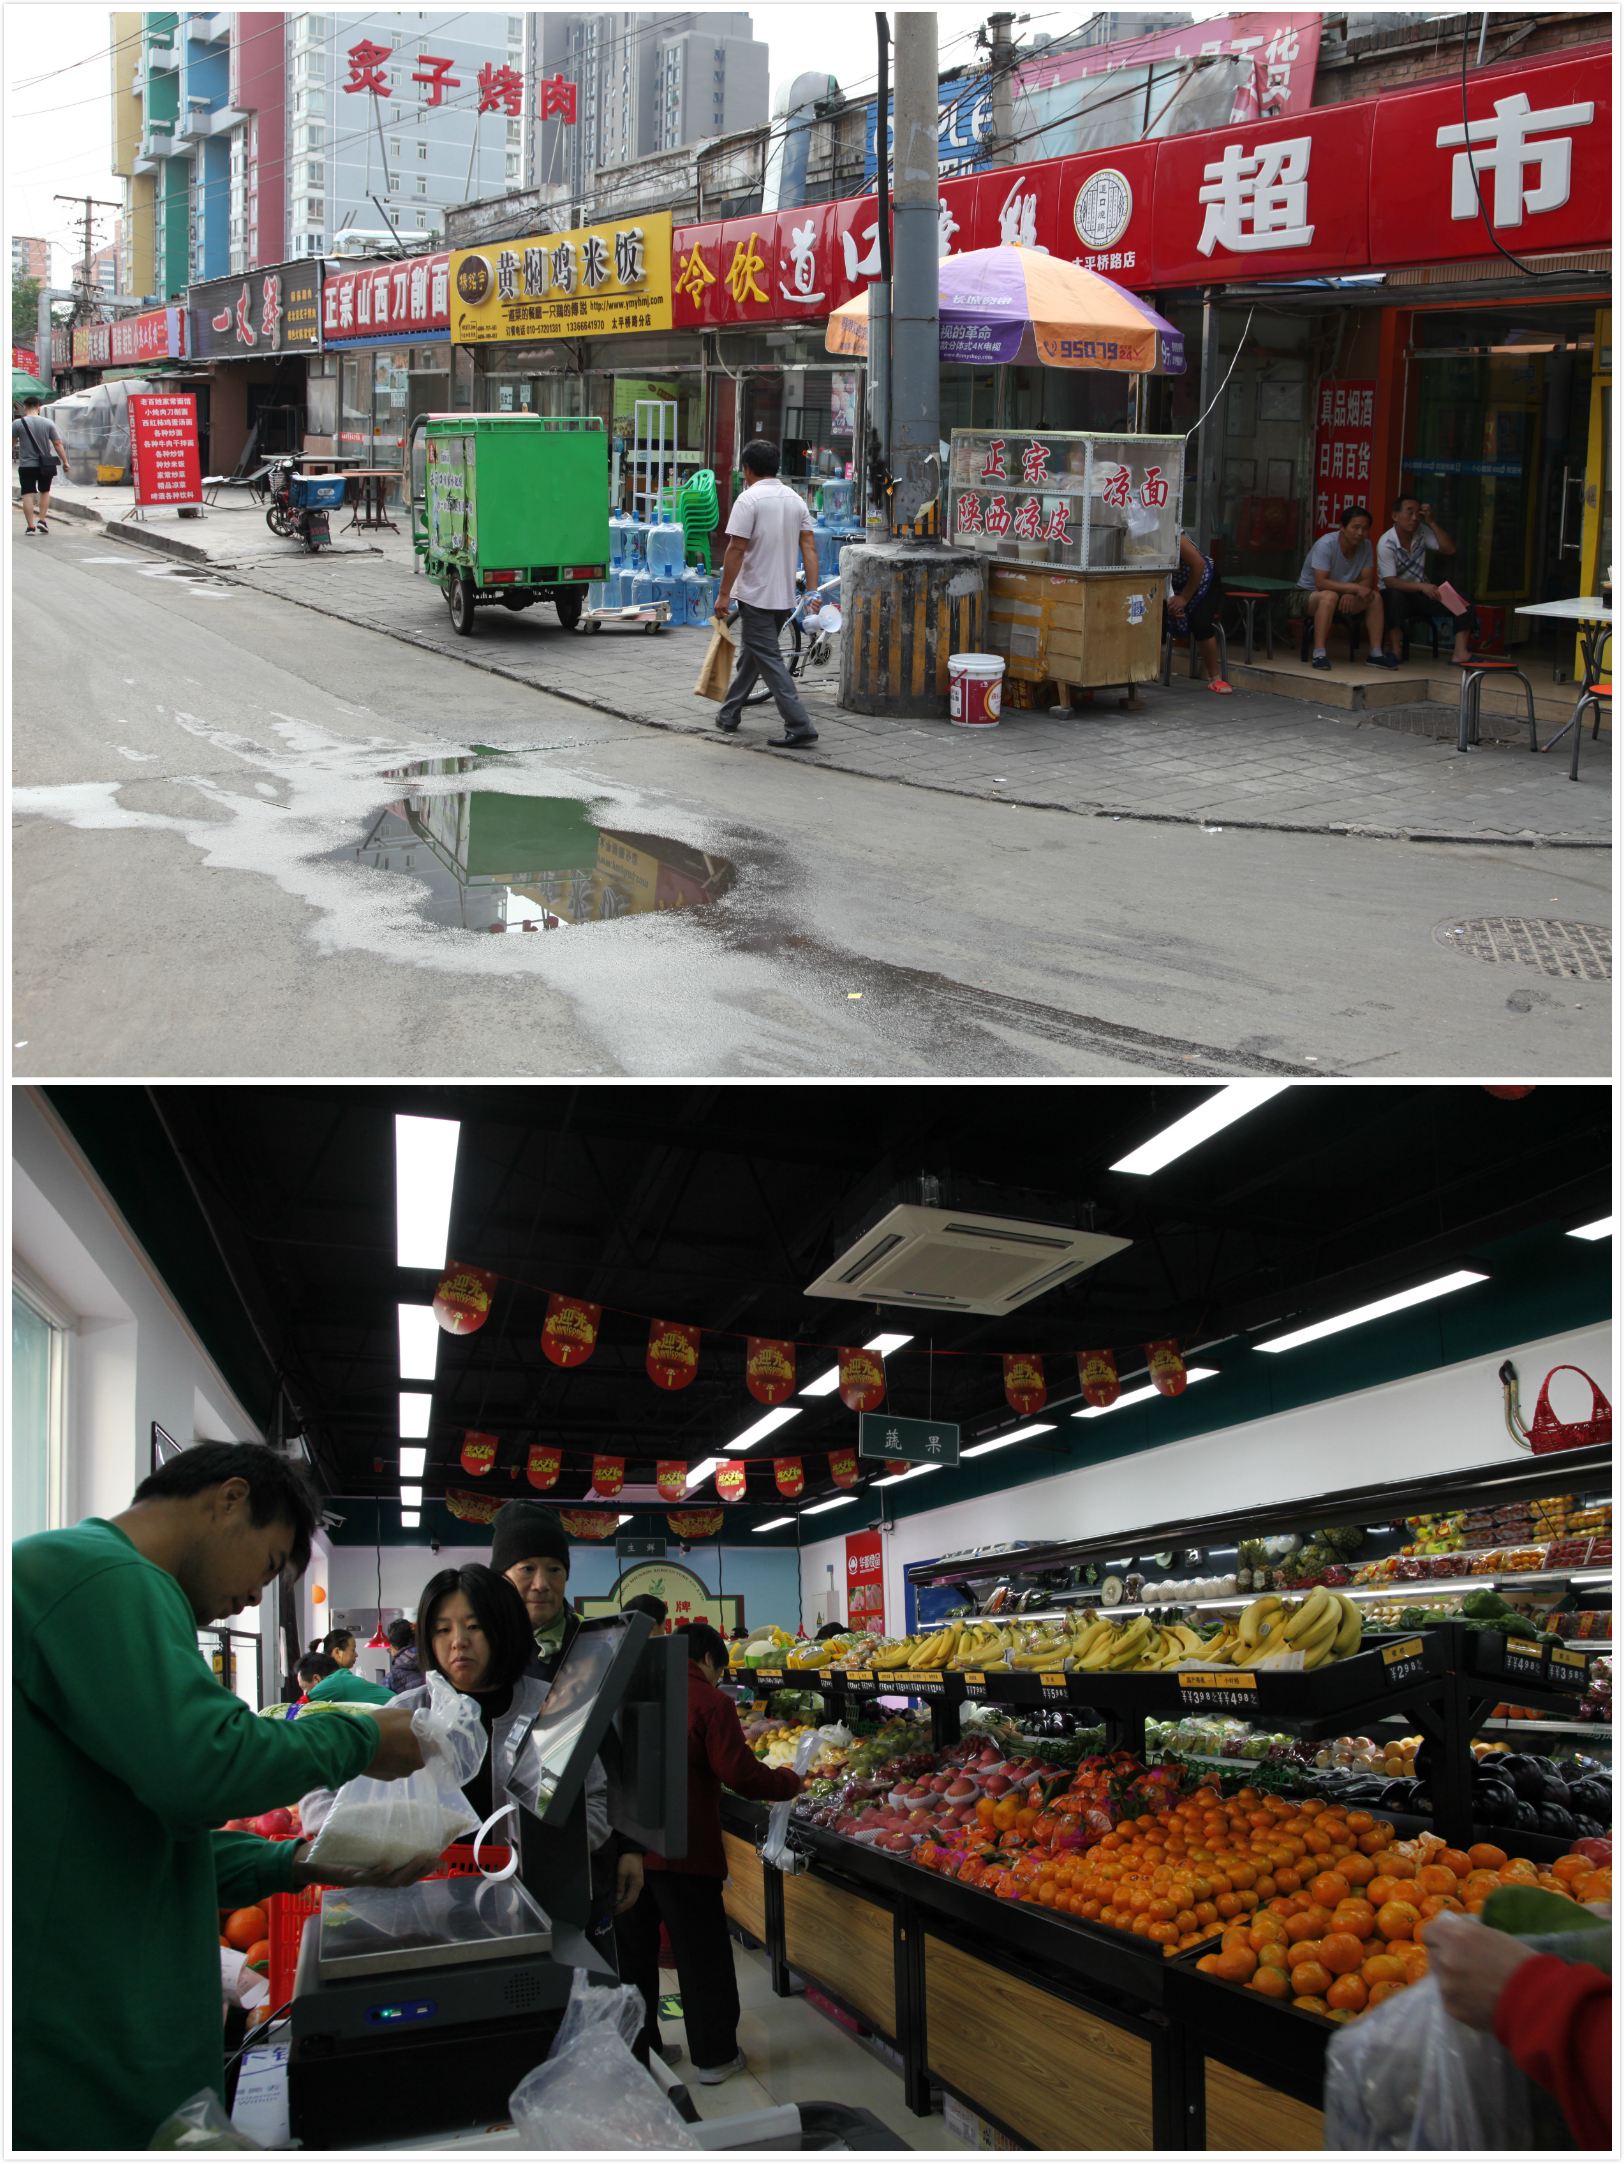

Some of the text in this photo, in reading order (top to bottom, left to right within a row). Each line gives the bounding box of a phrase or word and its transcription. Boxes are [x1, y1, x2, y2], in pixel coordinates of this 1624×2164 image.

[342, 38, 577, 124] 炙子烤肉
[1197, 93, 1595, 257] 超市
[495, 227, 647, 301] 黄焖鸡米饭
[674, 232, 770, 310] 冷饮
[324, 262, 450, 329] 正宗山西刀削面
[952, 295, 1013, 305] 长城宽带
[566, 320, 605, 332] 13366641970
[611, 314, 651, 330] 太平桥路分店
[940, 325, 993, 340] 视的革命
[1060, 340, 1119, 361] 95079
[1118, 350, 1133, 361] 24
[140, 398, 192, 406] 老百姓家常面馆
[1320, 388, 1374, 428] 真品烟酒
[141, 418, 193, 427] 西红柿鸡蛋汤面
[154, 429, 183, 437] 各种炒面
[143, 439, 195, 449] 各种牛肉干拌面
[156, 460, 186, 469] 种炒米饭
[980, 438, 1051, 484] 正宗
[1319, 441, 1372, 481] 日用百货
[156, 471, 186, 479] 家常炒菜
[157, 481, 187, 490] 精品凉菜
[1103, 465, 1170, 510] 凉面
[150, 491, 194, 500] 啤酒各种饮料
[885, 1428, 942, 1454] 蔬果
[627, 1543, 656, 1553] 生鲜
